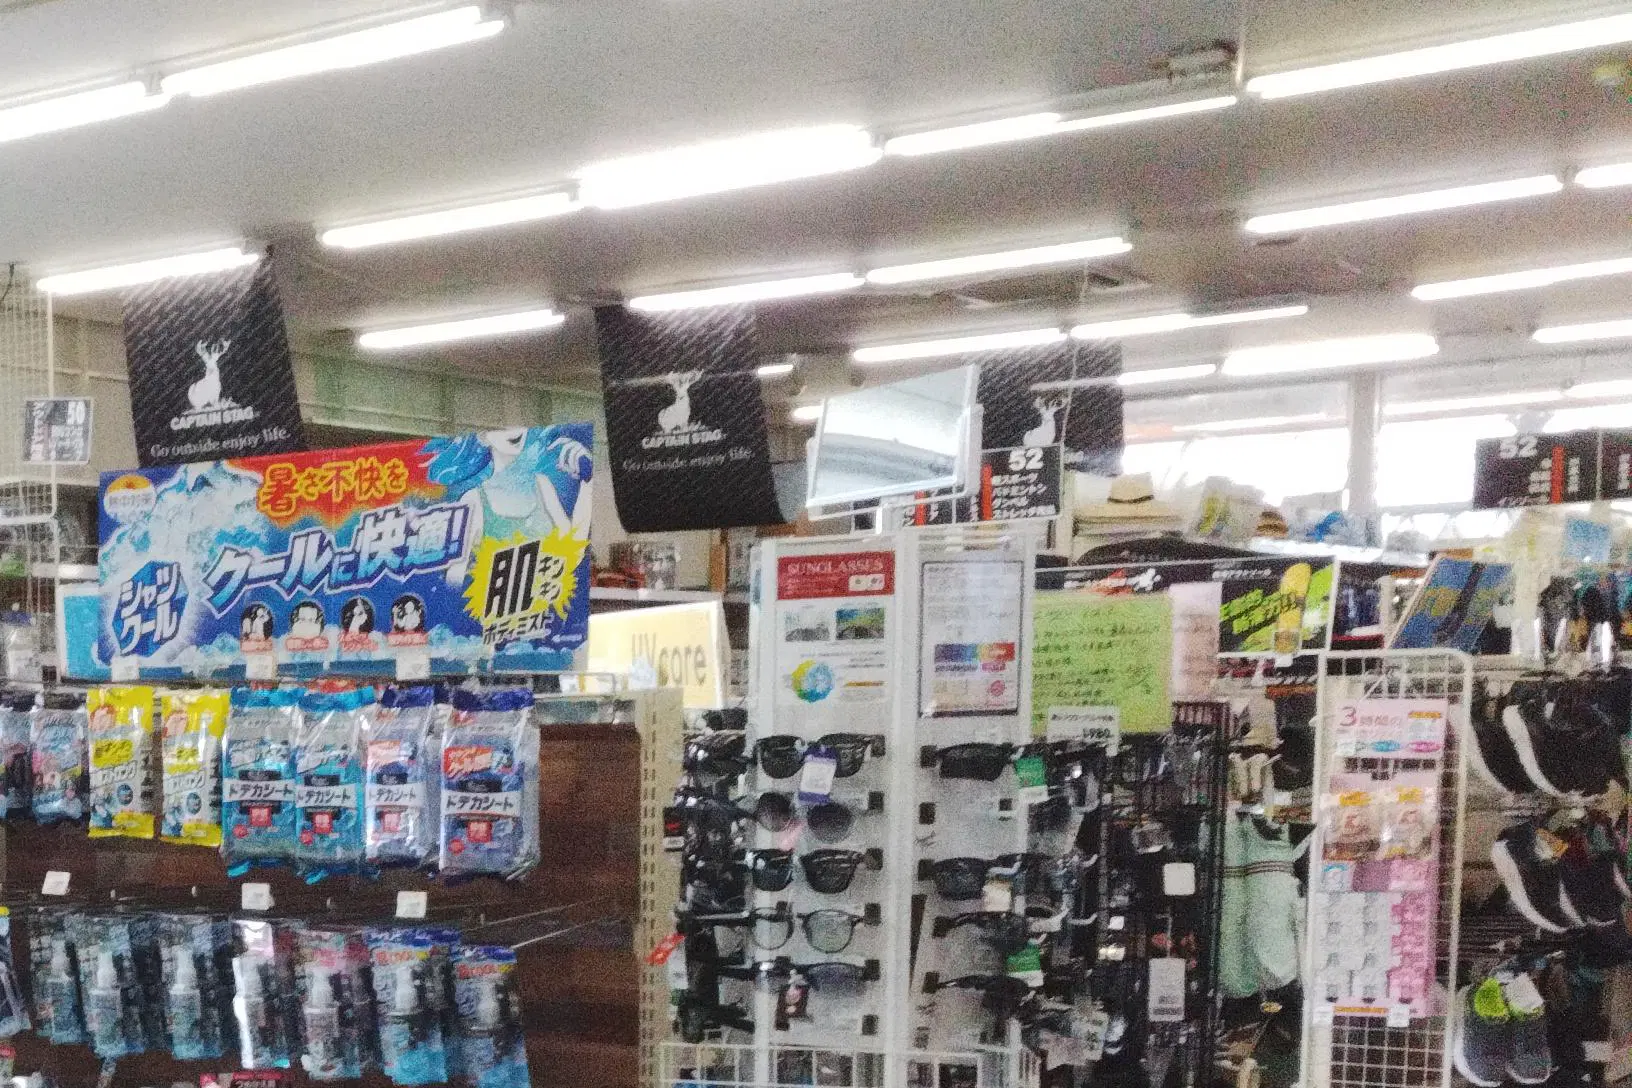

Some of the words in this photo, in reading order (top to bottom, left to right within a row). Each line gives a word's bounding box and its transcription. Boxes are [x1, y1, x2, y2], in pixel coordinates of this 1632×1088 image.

[170, 411, 222, 431] CAPTAIN
[223, 405, 256, 424] STAG
[150, 442, 170, 458] Go
[171, 435, 220, 455] outside
[222, 433, 261, 451] enjoy
[1009, 448, 1044, 472] 52
[1498, 436, 1538, 459] 52
[257, 457, 408, 516] 暑さ不快を
[119, 562, 180, 615] シャツ
[485, 540, 541, 617] 肌
[119, 603, 181, 657] クール
